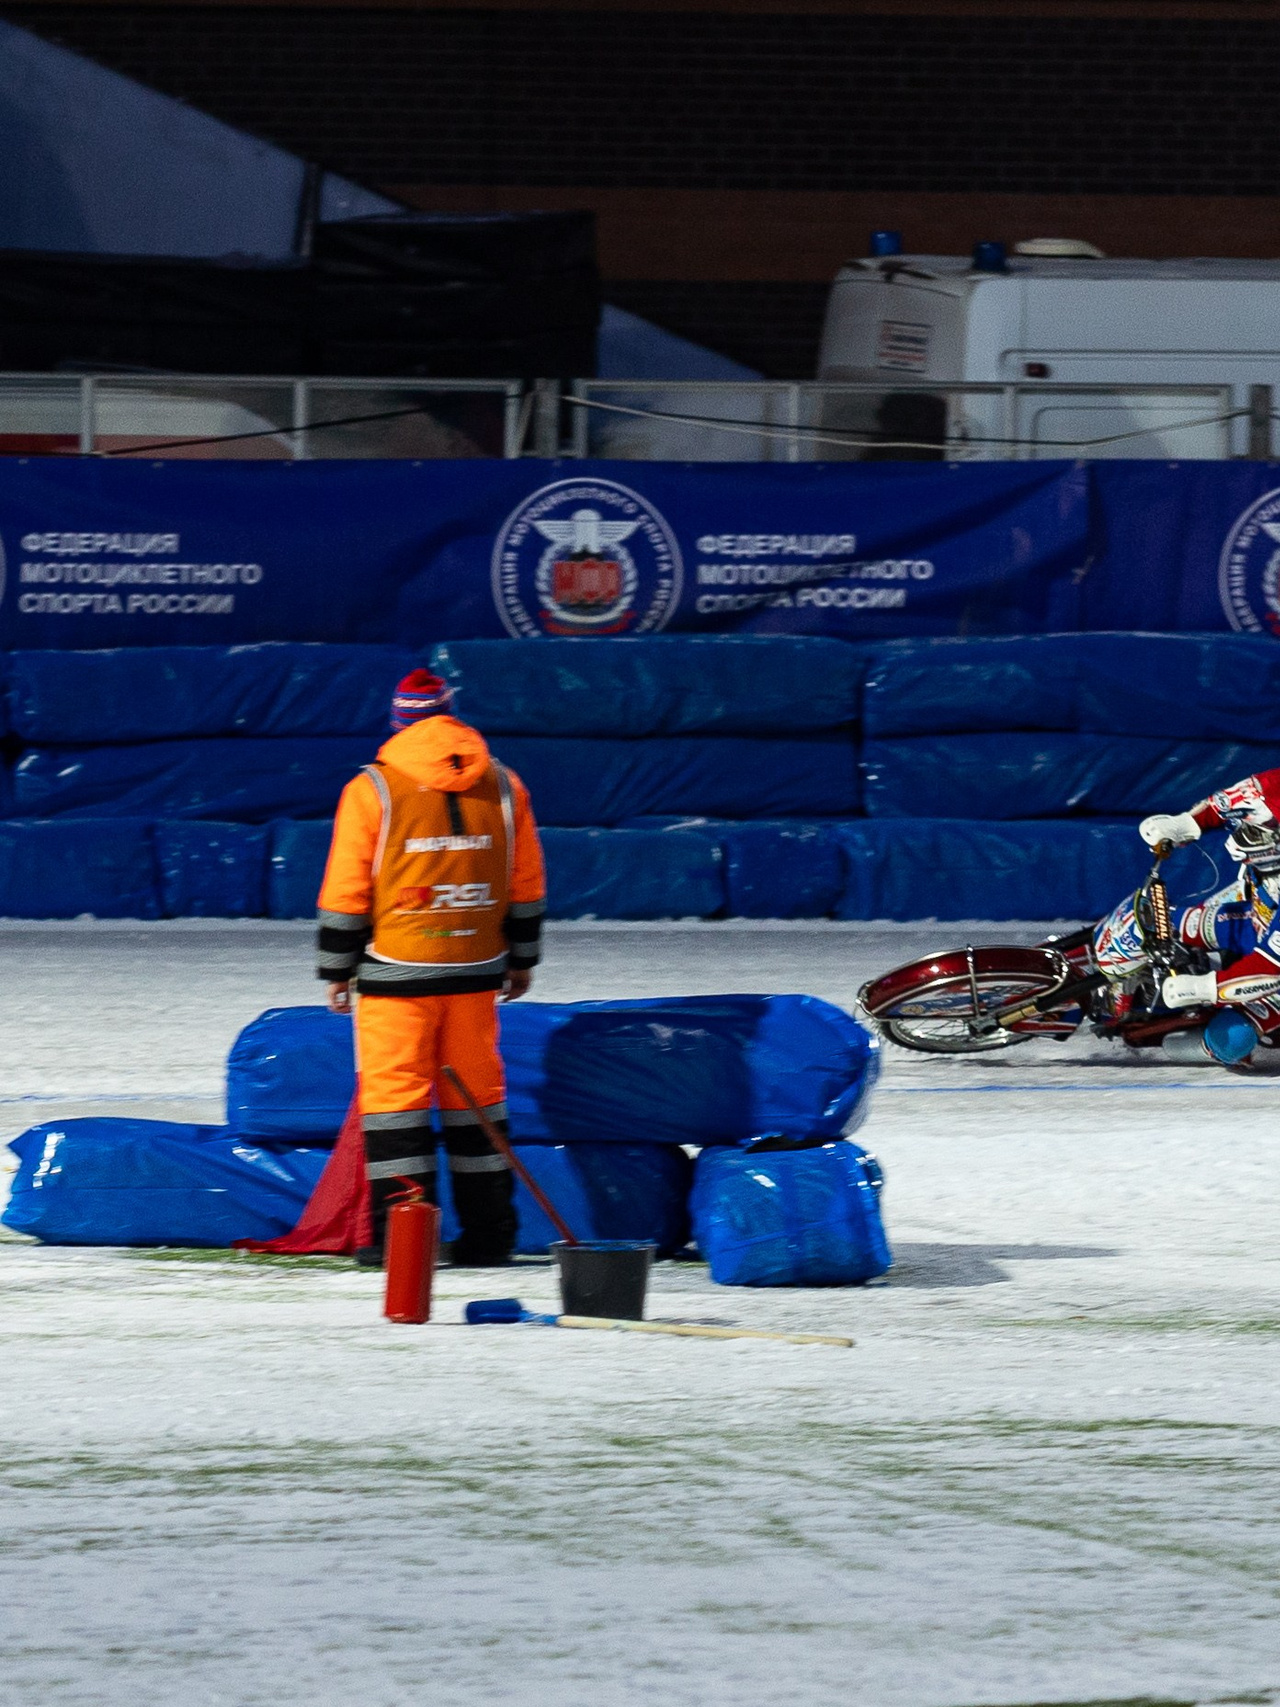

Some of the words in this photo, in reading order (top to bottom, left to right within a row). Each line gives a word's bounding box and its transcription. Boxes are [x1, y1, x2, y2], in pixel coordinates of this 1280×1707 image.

[20, 532, 180, 556] ФЕДЕРАЦИЯ
[696, 534, 856, 558] ФЕДЕРАЦИЯ
[20, 563, 263, 587] МОТОЦИКЛЕТНОГО
[18, 593, 123, 613] СПОРТА
[126, 593, 235, 613] РОССИИ
[796, 587, 906, 609] РОССИИ
[429, 882, 500, 909] RSL
